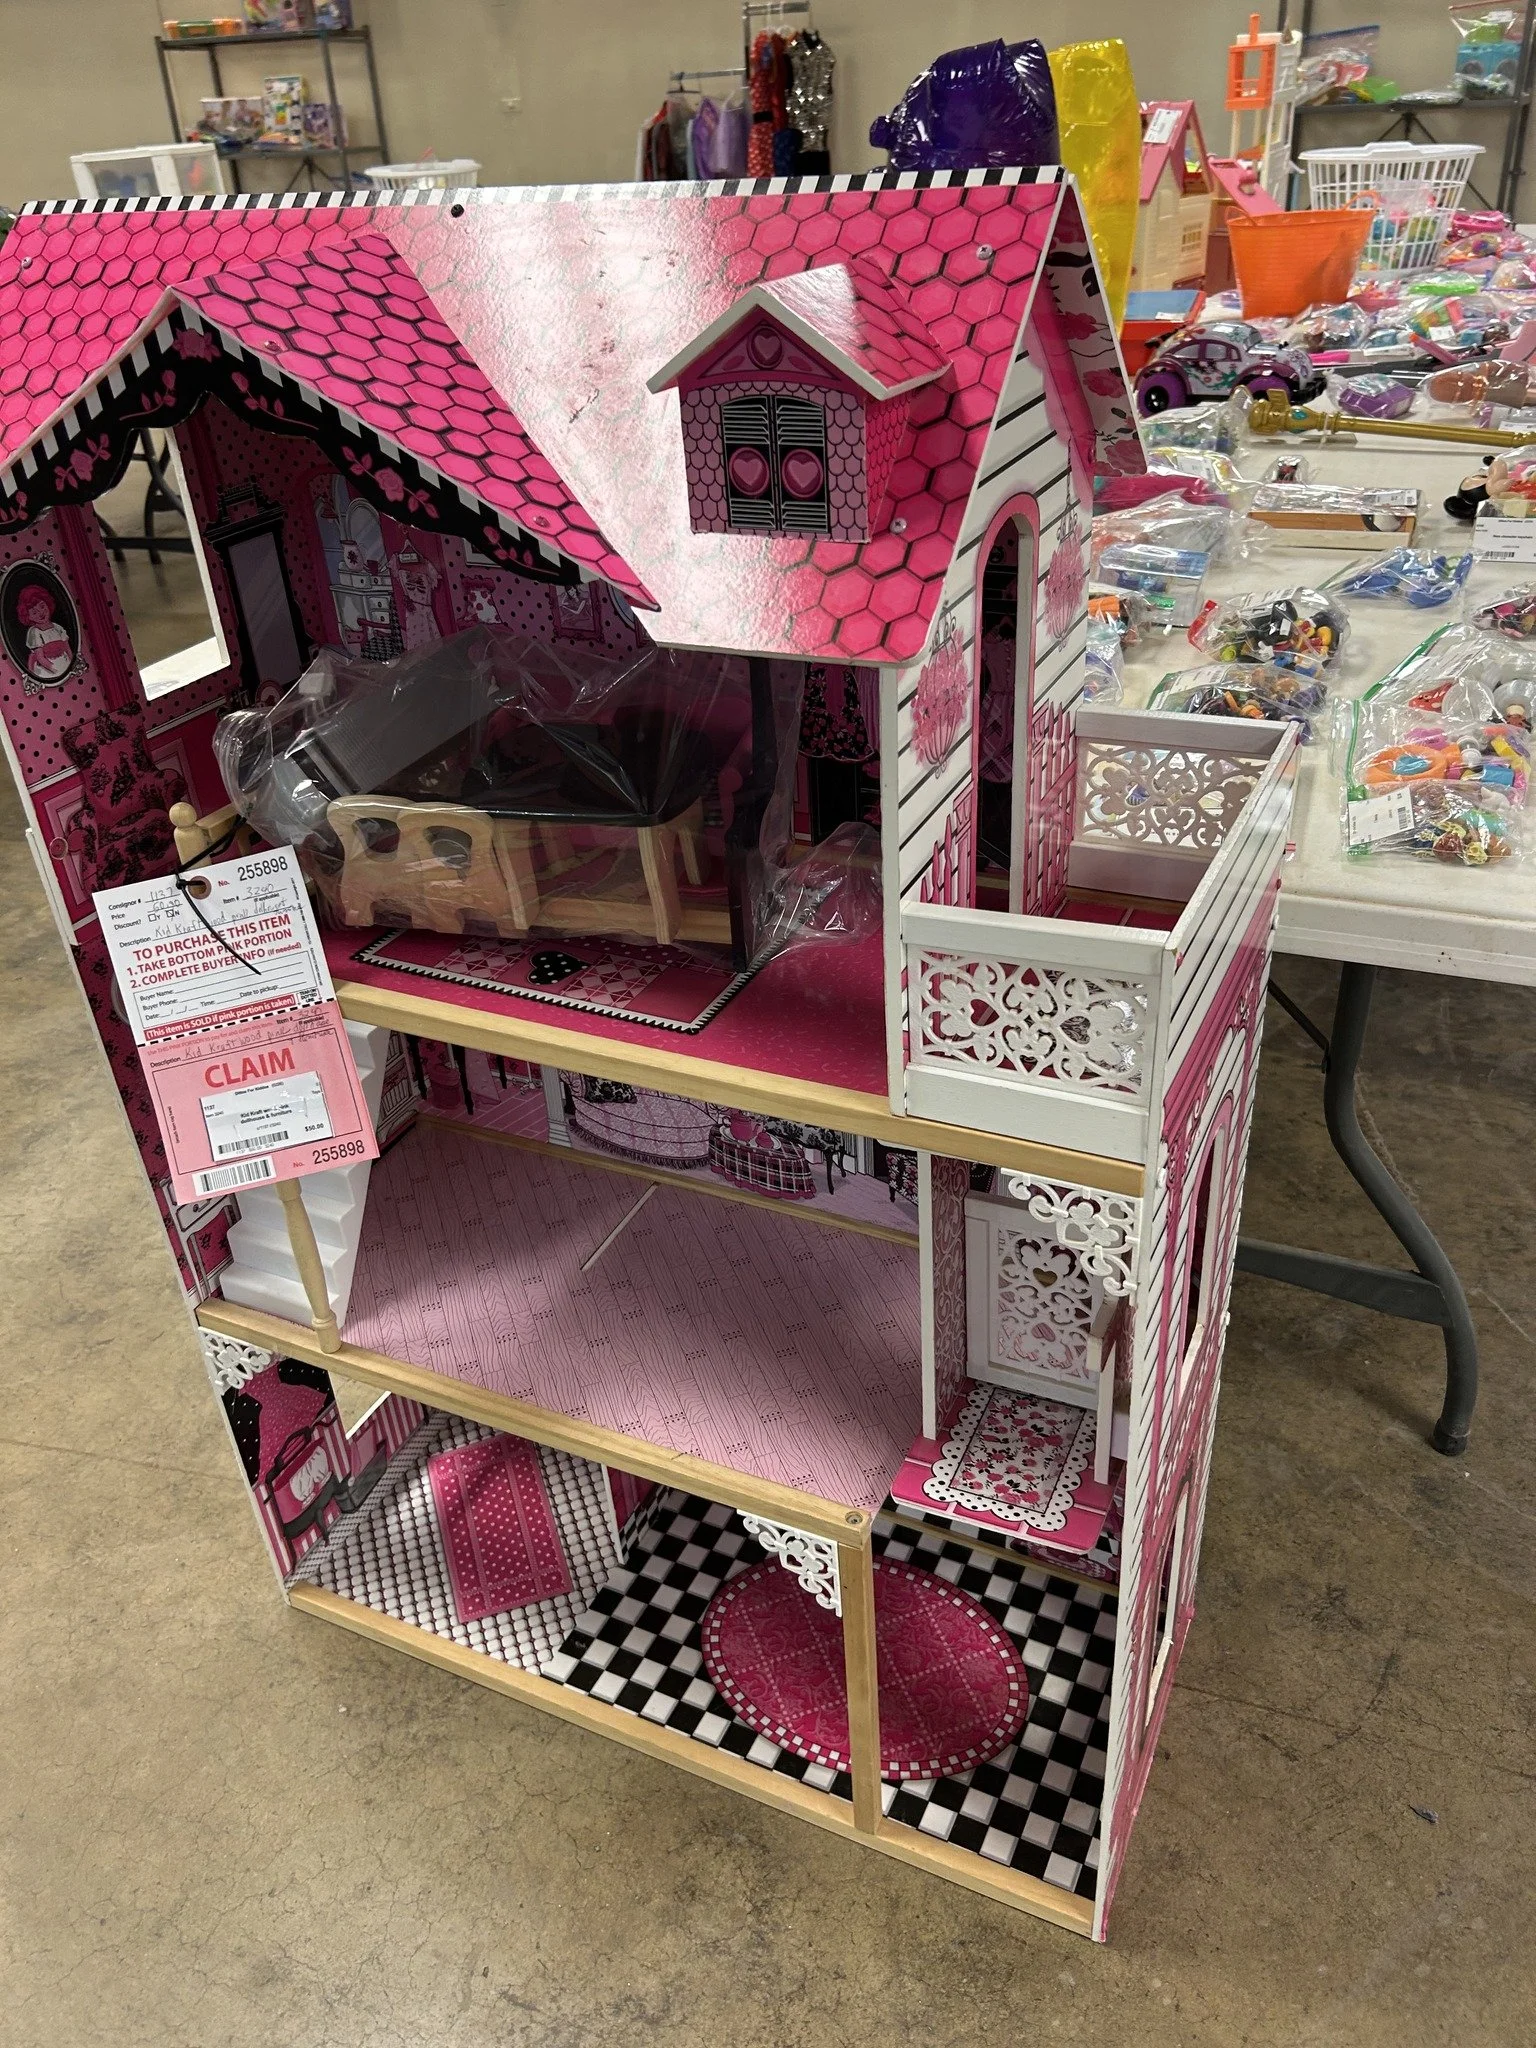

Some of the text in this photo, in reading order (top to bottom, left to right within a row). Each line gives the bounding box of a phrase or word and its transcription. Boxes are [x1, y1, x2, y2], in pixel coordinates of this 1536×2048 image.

[237, 856, 288, 881] 255898
[150, 887, 174, 901] 1137
[108, 900, 137, 911] Consignor
[111, 912, 126, 920] Price
[114, 918, 142, 930] Discount?
[119, 936, 152, 948] Description
[133, 948, 153, 960] TO
[154, 929, 226, 956] PURCHASE
[227, 922, 257, 939] THIS
[259, 913, 292, 931] ITEM
[127, 967, 138, 976] 1.
[137, 959, 167, 974] TAKE
[168, 947, 215, 966] BOTTOM
[244, 928, 292, 948] PORTION
[130, 979, 141, 988] 2.
[141, 964, 201, 985] COMPLETE
[202, 955, 239, 972] BUYER
[275, 941, 302, 954] needed)
[140, 989, 174, 1002] Buyer Name:
[239, 990, 253, 998] Date
[259, 984, 279, 993] pickup:
[142, 999, 178, 1012] Buyer Phone:
[146, 1029, 165, 1039] (This
[165, 1025, 183, 1034] item
[190, 1016, 211, 1027] SOLD
[219, 1010, 236, 1022] pink
[236, 1004, 264, 1017] portion
[271, 995, 295, 1008] taken)
[150, 1057, 181, 1068] Description
[205, 1047, 296, 1089] CLAIM
[240, 1114, 265, 1124] dollhouse
[250, 1108, 263, 1117] Kraft
[304, 1123, 324, 1132] $50.00
[312, 1139, 365, 1165] 255898
